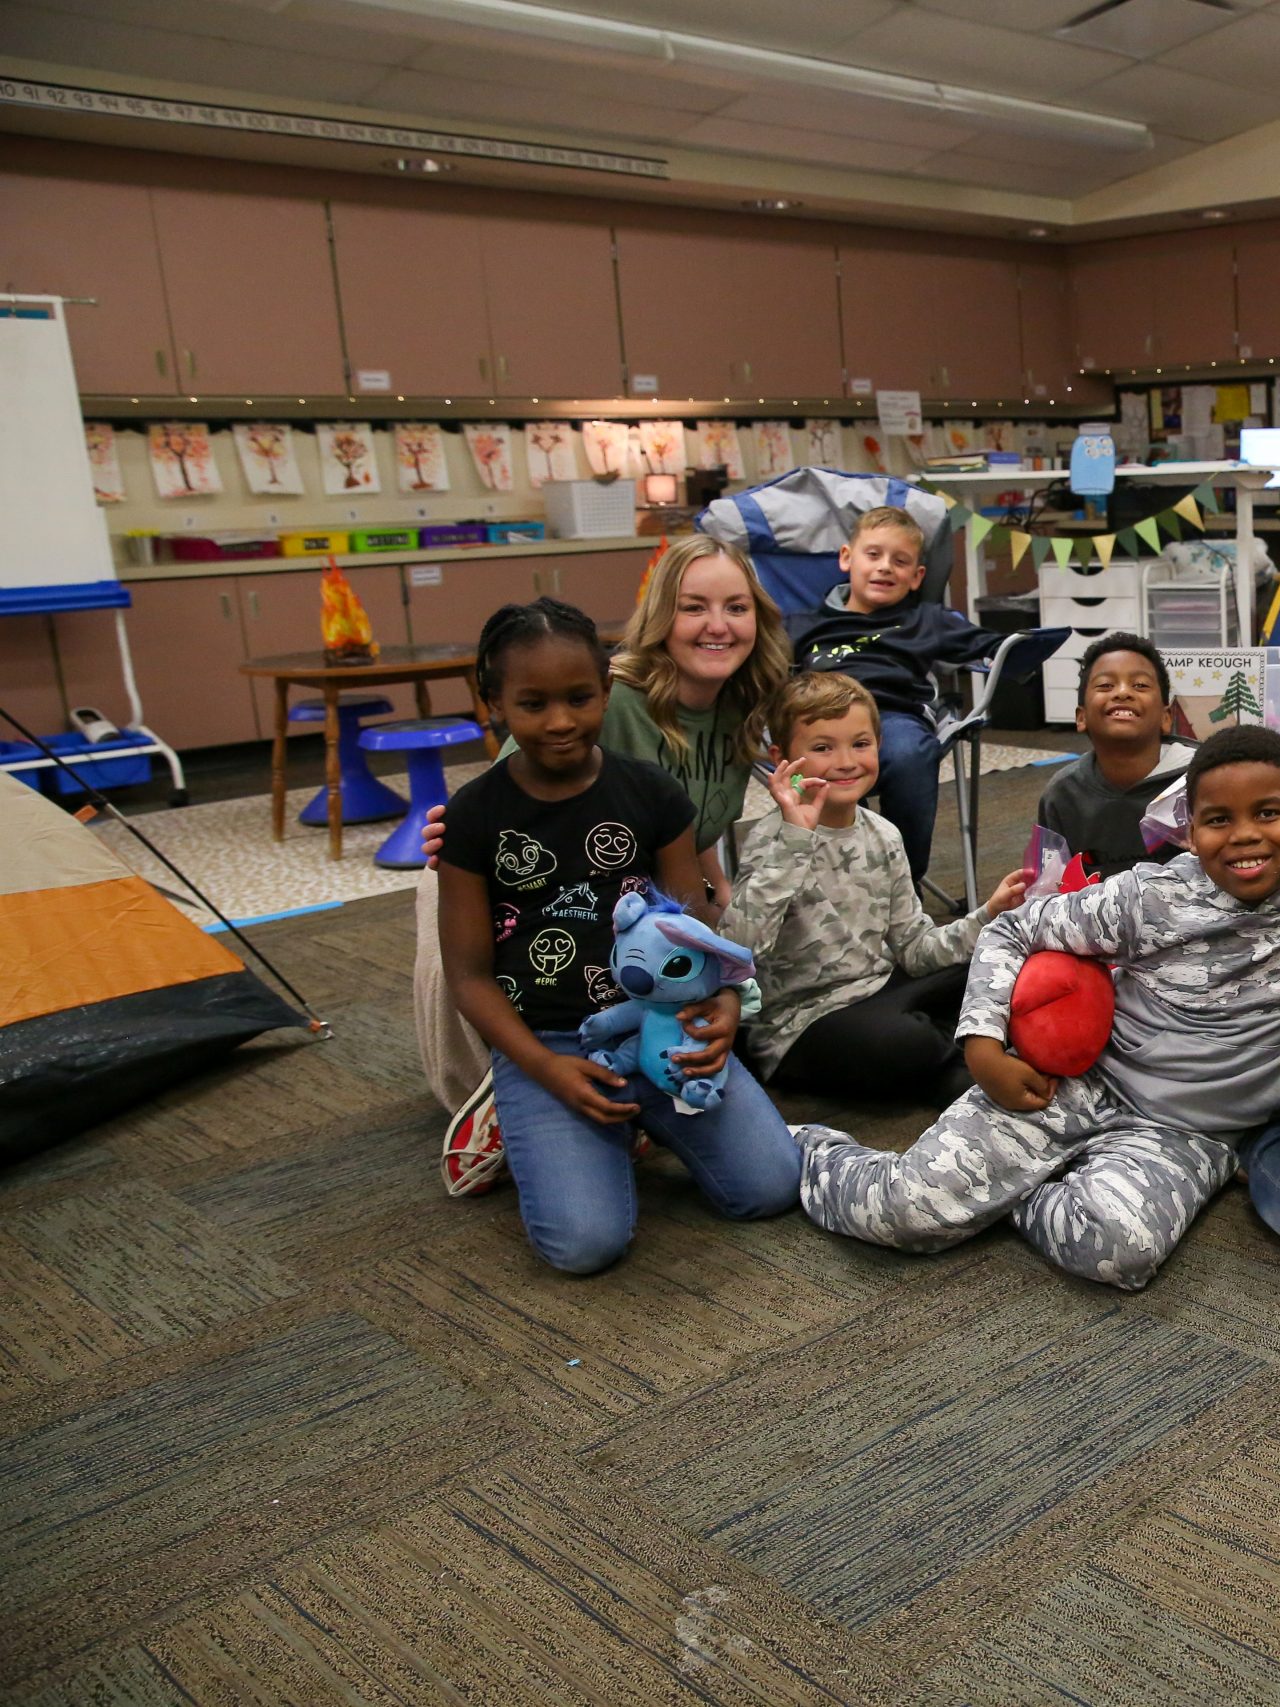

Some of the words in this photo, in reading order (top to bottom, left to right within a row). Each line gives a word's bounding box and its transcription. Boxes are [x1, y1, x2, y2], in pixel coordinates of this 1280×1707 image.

[1163, 657, 1194, 669] AMP
[1198, 657, 1252, 669] KEOUGH
[551, 908, 599, 921] #AESTHETIC
[534, 977, 558, 986] #EPIC
